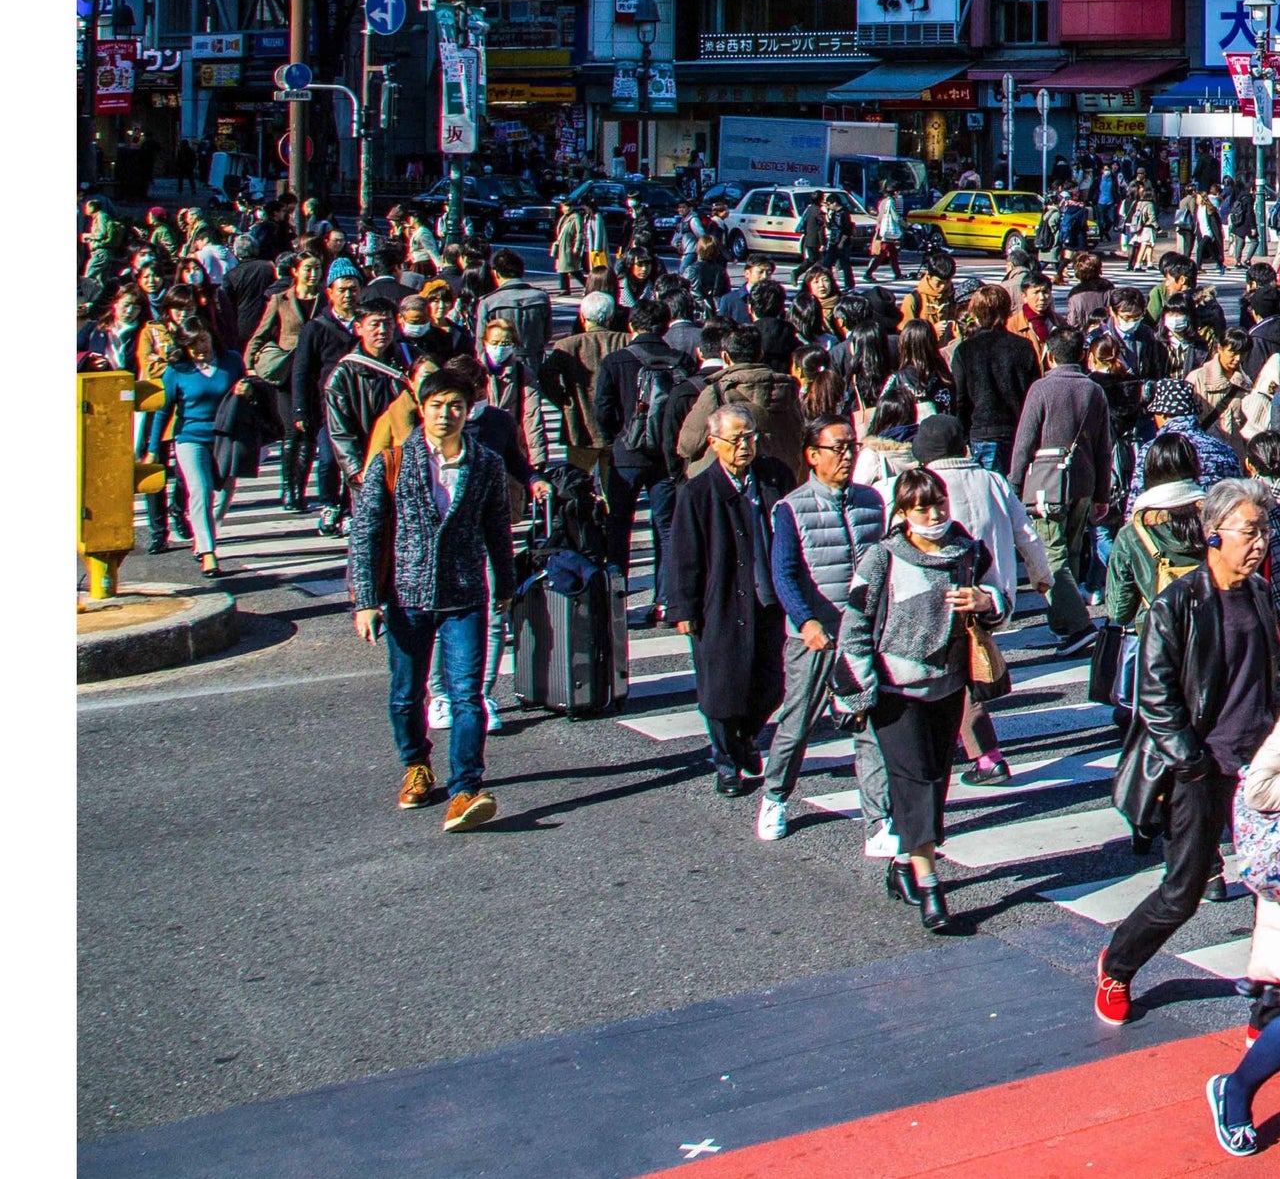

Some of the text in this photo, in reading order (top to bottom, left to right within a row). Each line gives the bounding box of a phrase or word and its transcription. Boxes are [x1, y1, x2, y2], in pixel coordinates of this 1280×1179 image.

[705, 39, 753, 53] 渋谷西村
[1117, 118, 1145, 131] Free
[446, 125, 463, 143] 坂
